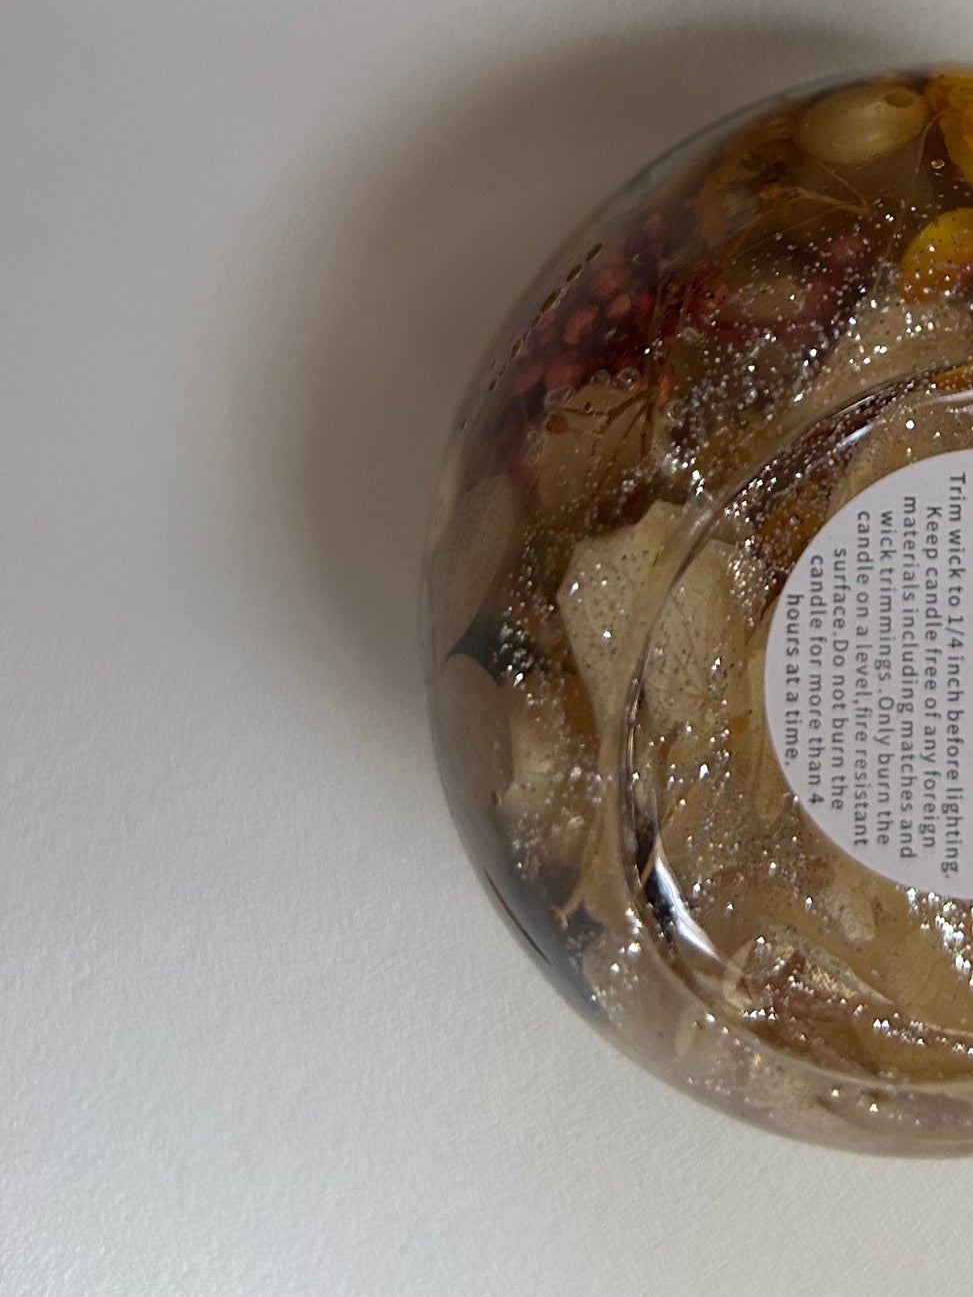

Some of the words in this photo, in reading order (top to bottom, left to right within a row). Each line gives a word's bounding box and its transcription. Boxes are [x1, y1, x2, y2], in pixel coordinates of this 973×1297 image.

[948, 471, 967, 522] Trim
[856, 510, 874, 585] candle
[879, 510, 898, 561] wick
[902, 496, 920, 602] materials
[921, 506, 943, 560] Keep
[948, 528, 966, 579] wick
[809, 554, 828, 629] candle
[855, 591, 869, 618] on
[924, 566, 943, 641] candle
[947, 585, 963, 608] to
[785, 593, 805, 657] hours
[855, 625, 869, 637] a
[945, 614, 965, 649] 1/4
[785, 663, 801, 685] at
[809, 636, 828, 667] for
[896, 608, 919, 714] including
[924, 648, 943, 691] free
[785, 691, 799, 703] a
[808, 674, 822, 730] more
[831, 674, 847, 711] not
[947, 655, 965, 703] inch
[924, 697, 942, 719] of
[785, 709, 803, 766] time.
[807, 736, 826, 787] than
[831, 717, 850, 768] burn
[919, 725, 937, 764] any
[946, 709, 965, 781] before
[877, 753, 895, 804] burn
[900, 720, 918, 813] matches
[808, 792, 825, 805] 4
[831, 775, 849, 811] the
[853, 749, 871, 847] resistant
[918, 770, 942, 848] foreign
[876, 810, 894, 845] the
[899, 819, 918, 859] and
[940, 787, 964, 879] lighting.
